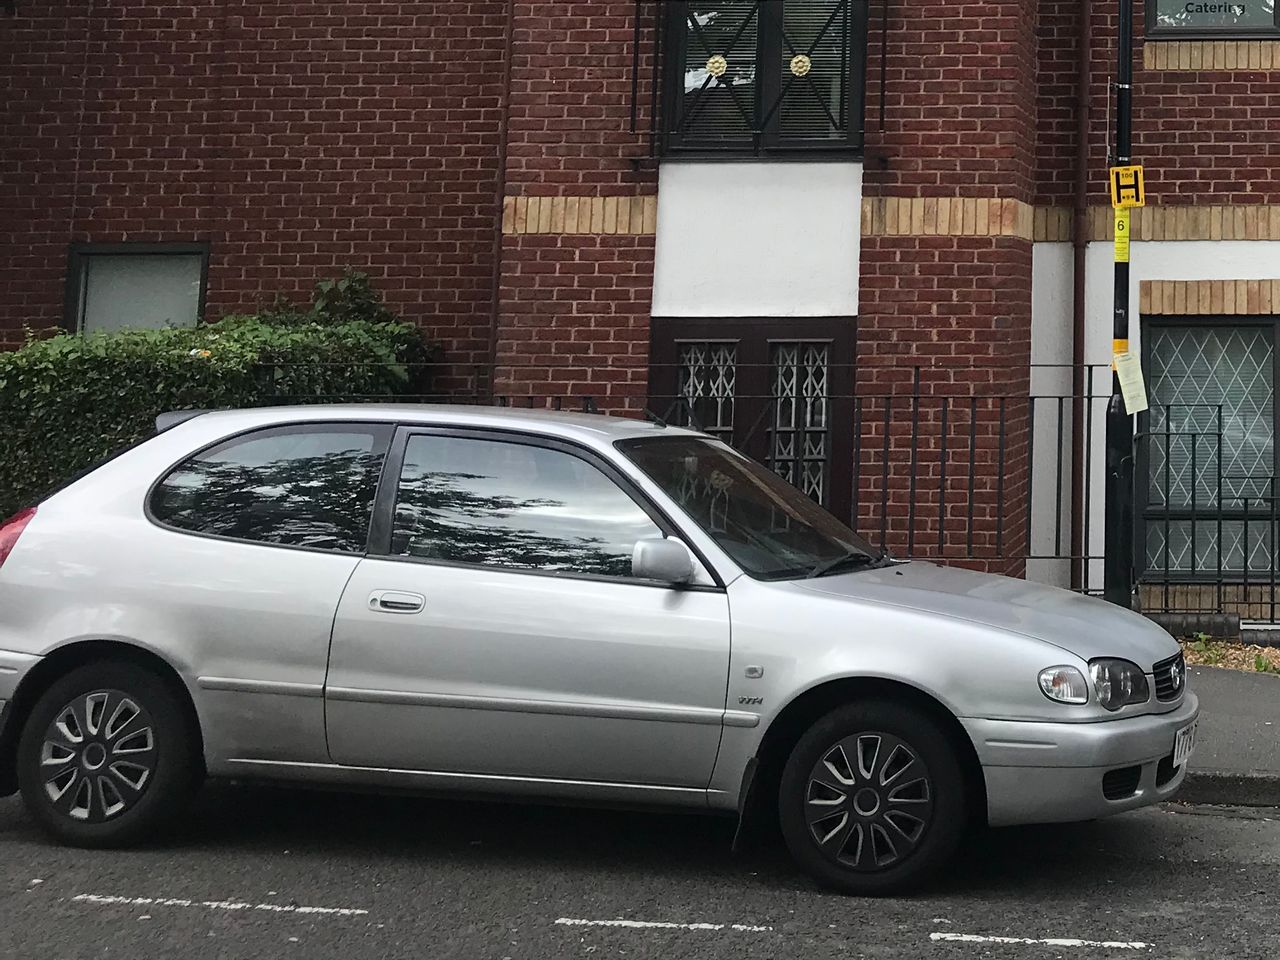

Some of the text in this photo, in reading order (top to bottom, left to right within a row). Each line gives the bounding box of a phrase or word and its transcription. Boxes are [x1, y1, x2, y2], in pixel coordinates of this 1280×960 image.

[1185, 2, 1246, 14] Catering
[1115, 170, 1140, 204] H
[1117, 220, 1124, 231] 6
